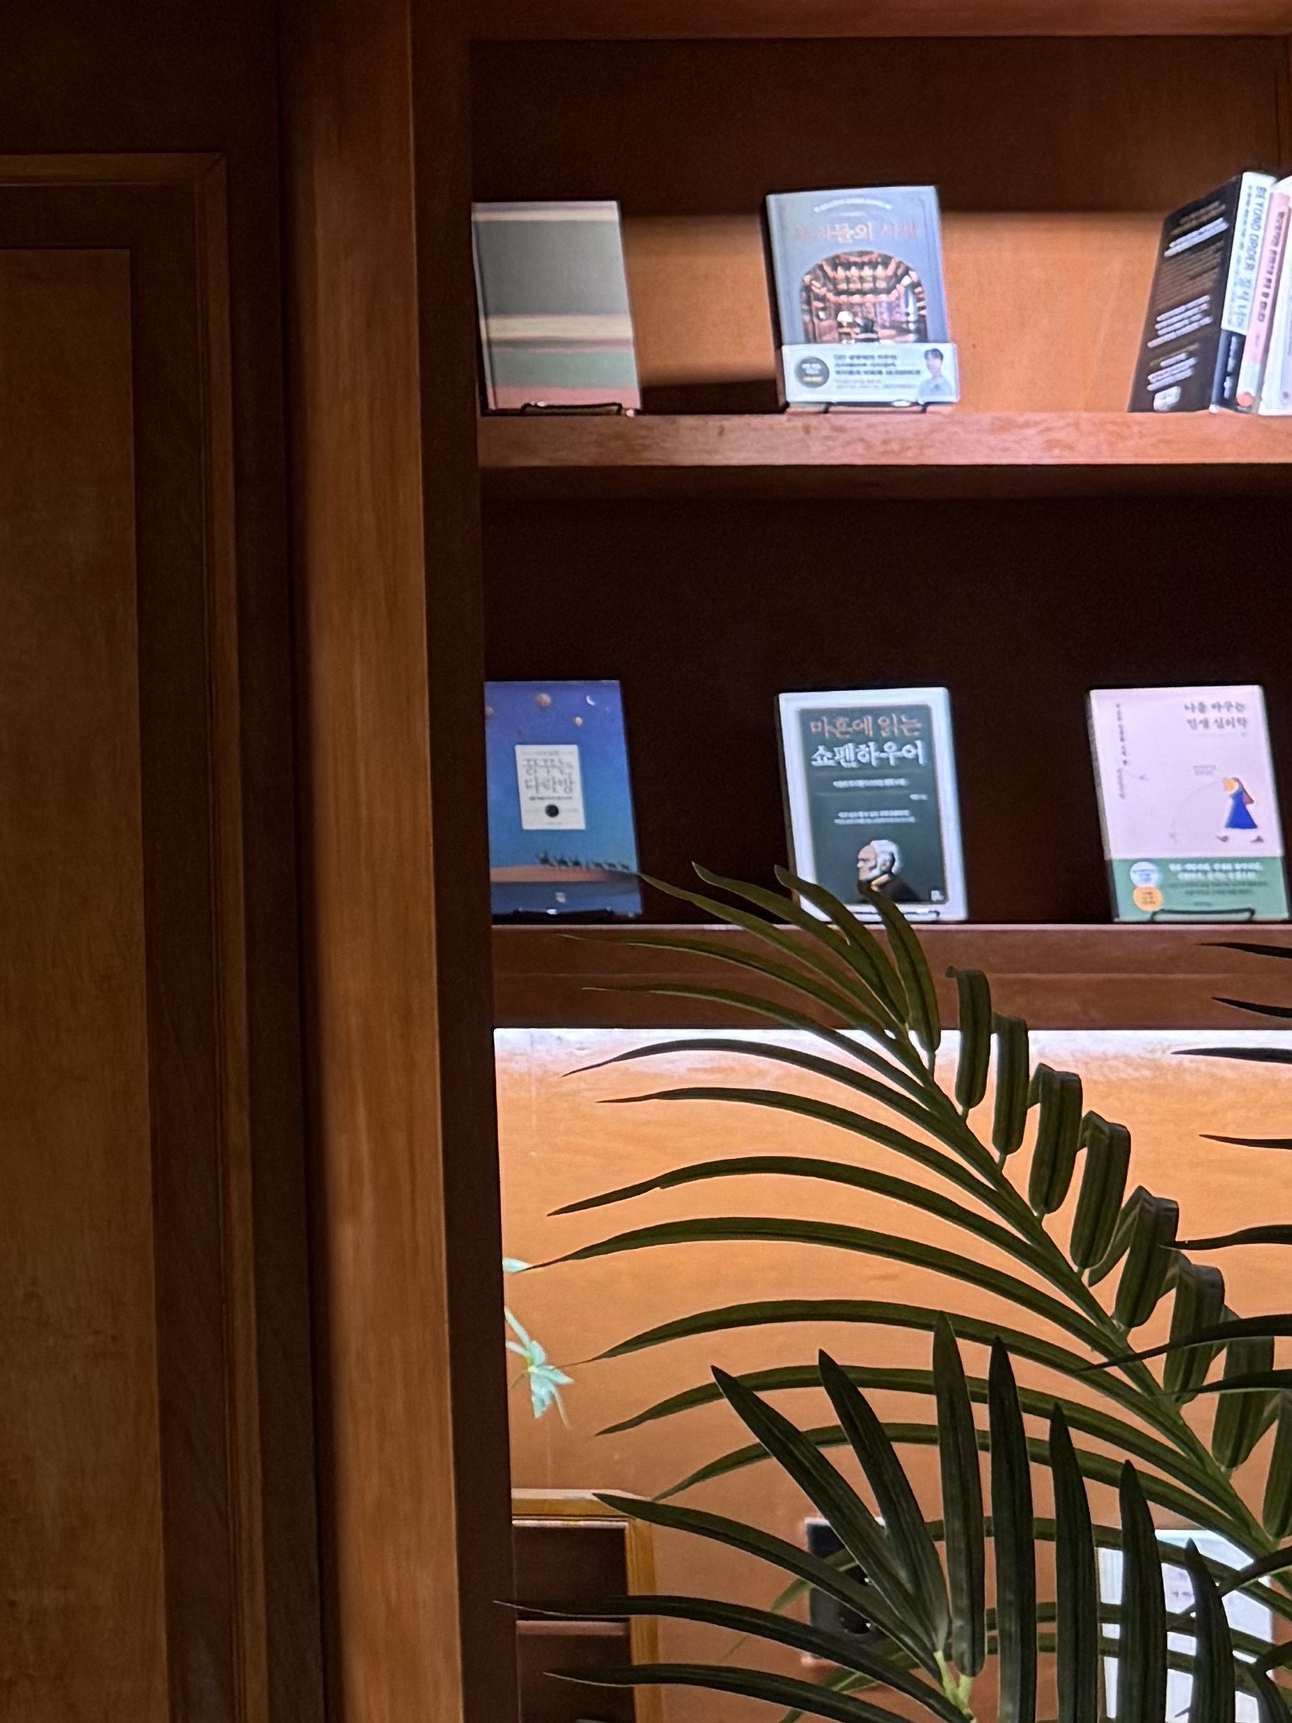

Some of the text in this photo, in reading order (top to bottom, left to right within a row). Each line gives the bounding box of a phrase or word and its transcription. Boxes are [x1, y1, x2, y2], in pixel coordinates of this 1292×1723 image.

[810, 713, 923, 739] 마흔에 읽는
[810, 740, 927, 768] 쇼펜하우어
